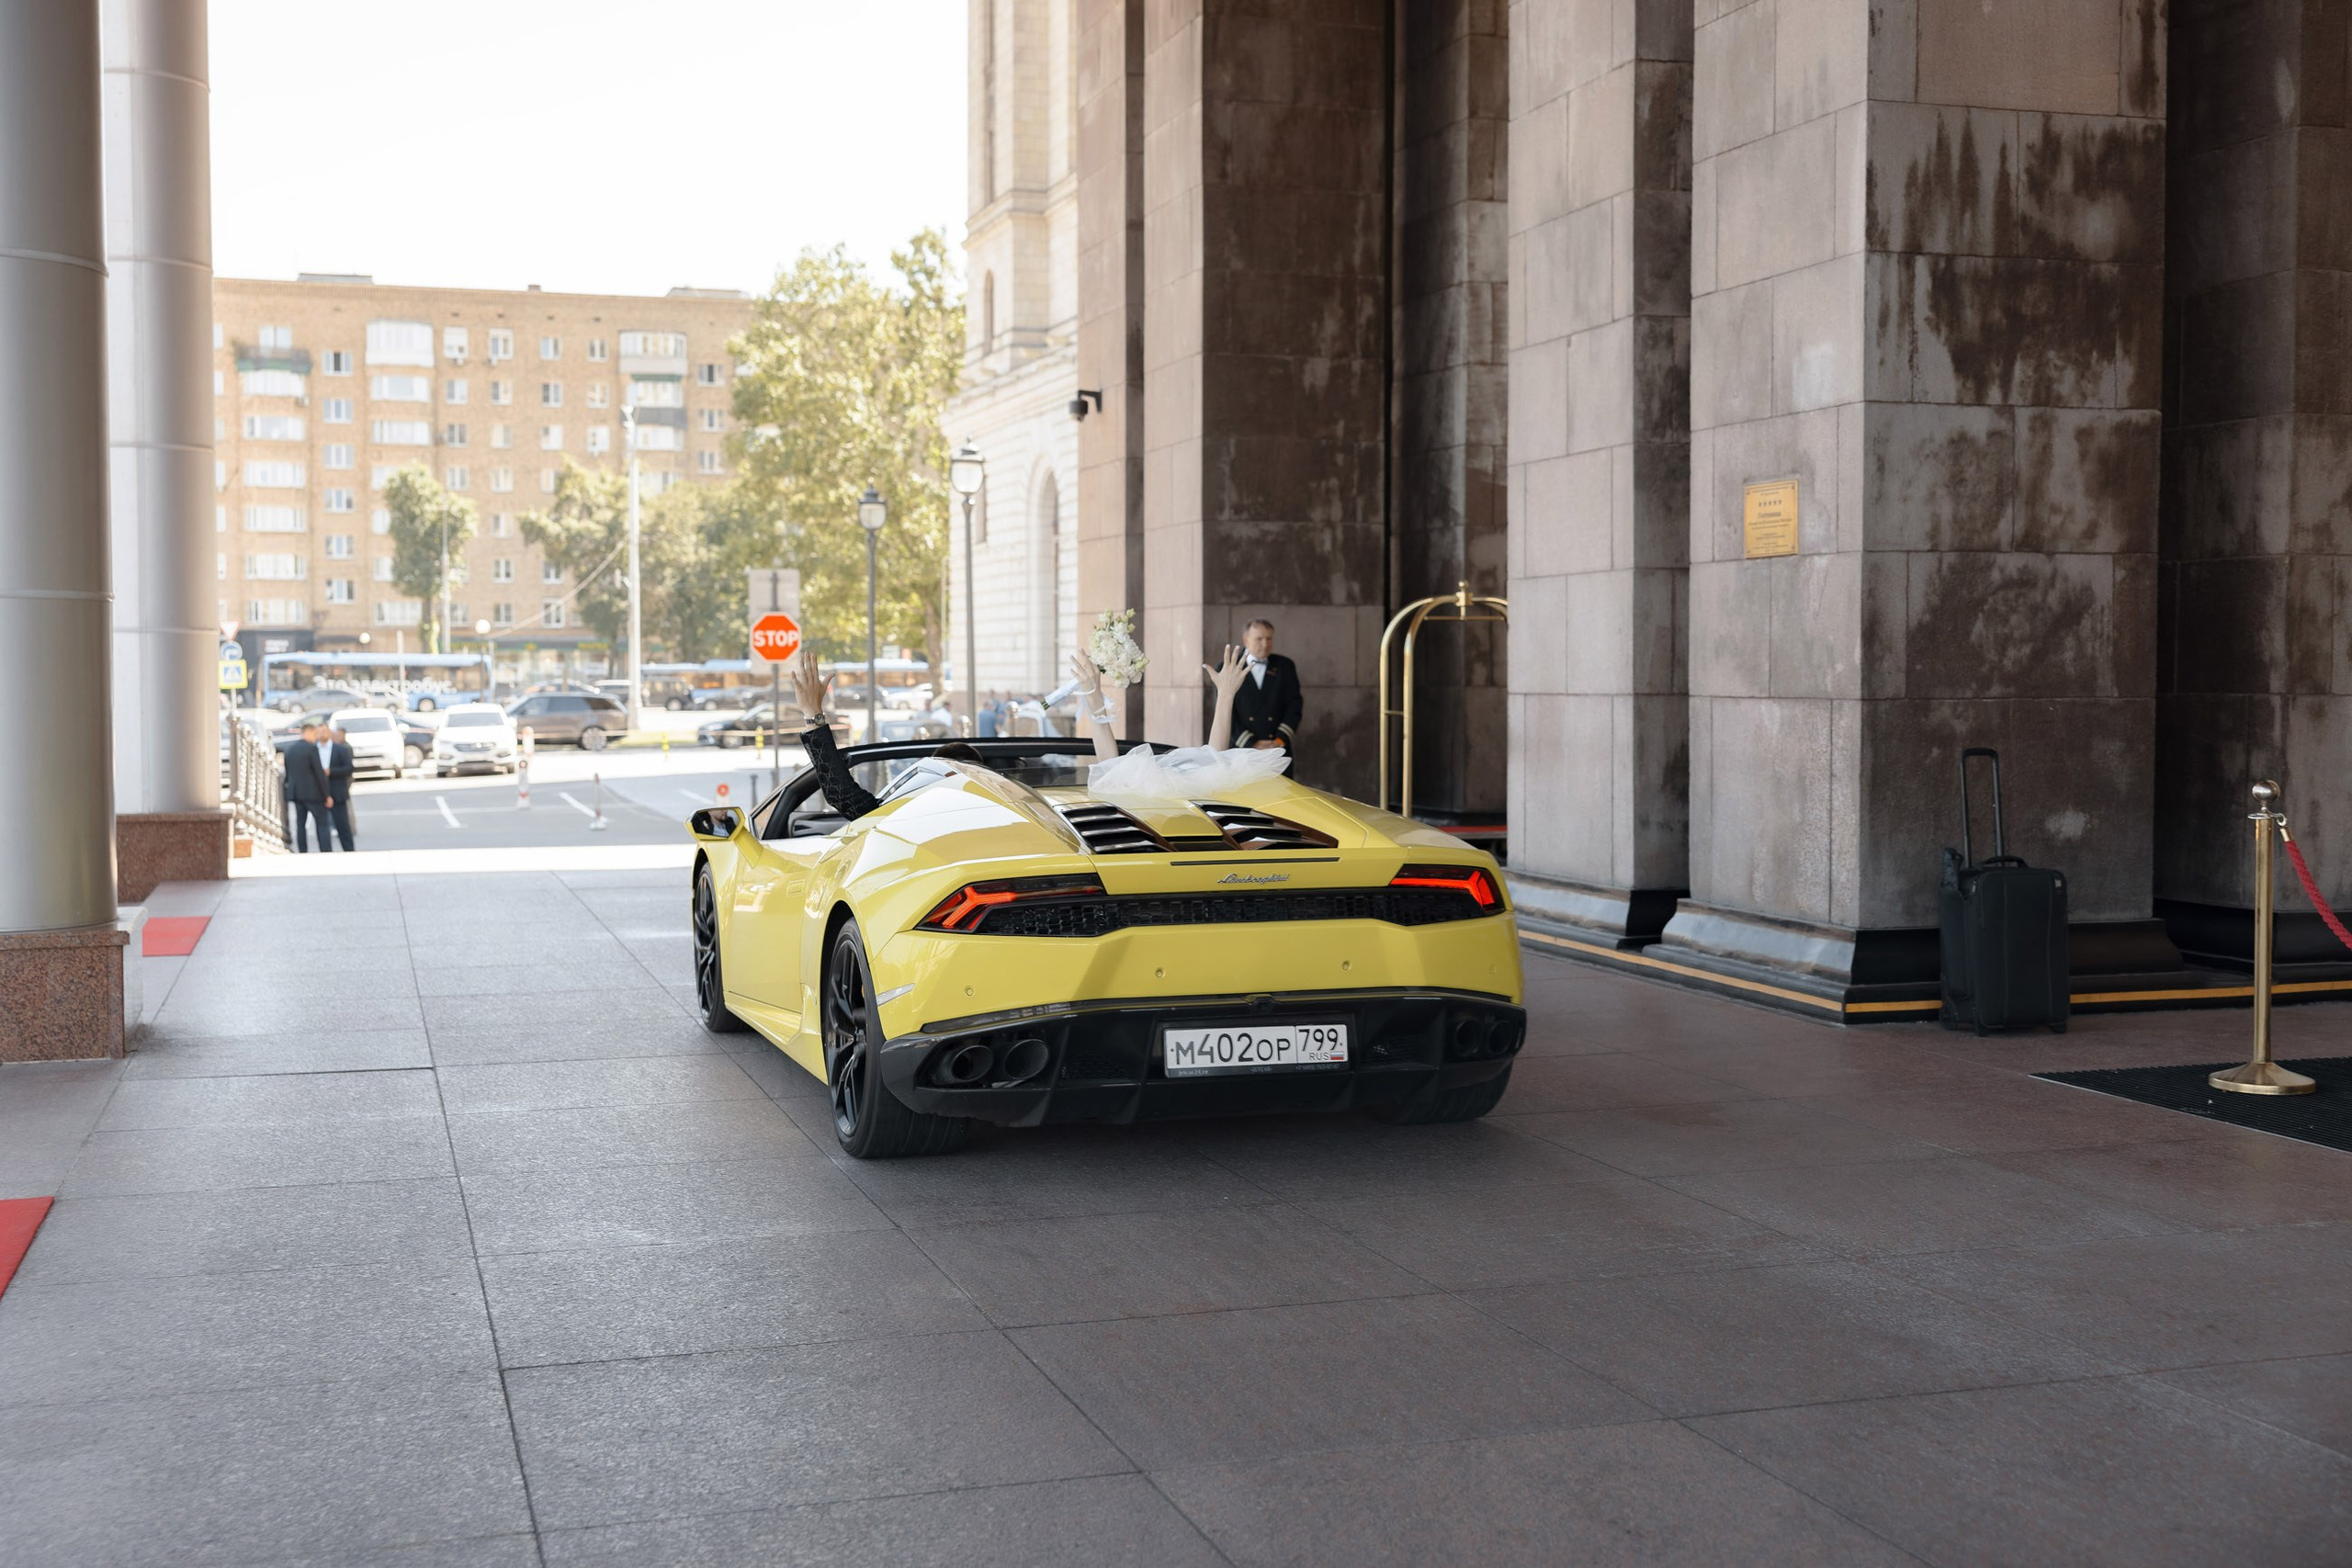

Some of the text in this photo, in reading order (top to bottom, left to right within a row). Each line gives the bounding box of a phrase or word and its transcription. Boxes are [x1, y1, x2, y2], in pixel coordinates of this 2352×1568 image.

[753, 629, 798, 648] STOP
[1298, 1028, 1339, 1052] 799
[1309, 1052, 1329, 1061] RUS
